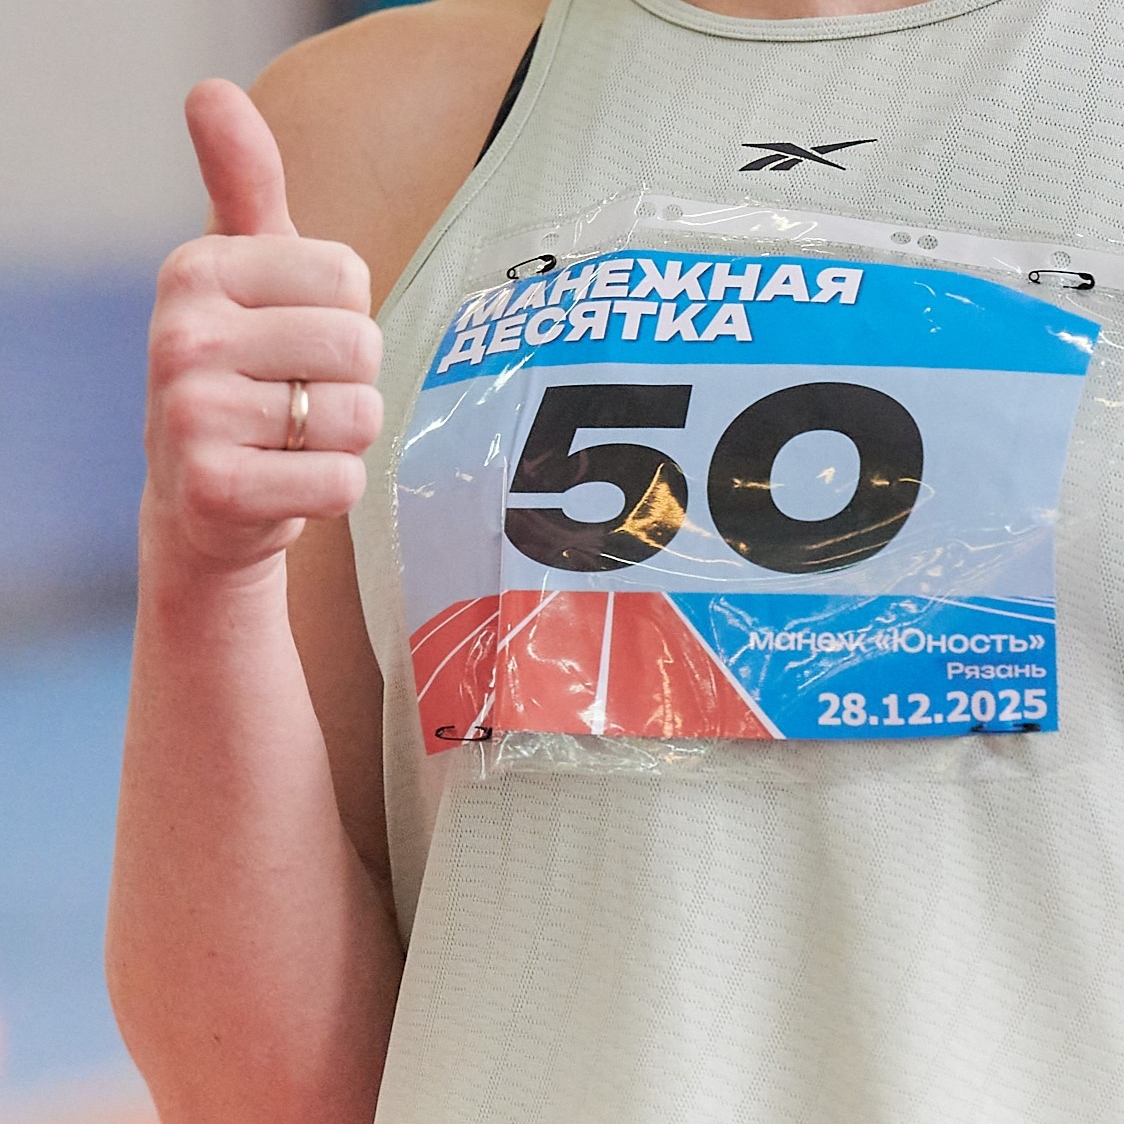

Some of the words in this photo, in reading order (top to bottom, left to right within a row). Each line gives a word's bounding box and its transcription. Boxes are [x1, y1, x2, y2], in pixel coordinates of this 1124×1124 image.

[454, 258, 865, 333] МАНЕЖНАЯ
[436, 299, 754, 374] ДЕСЯТКА
[503, 381, 925, 574] 50
[749, 629, 867, 653] манеж
[875, 627, 1046, 654] «Юность»
[946, 661, 1047, 681] Рязань
[817, 688, 1048, 727] 28.12.2025
